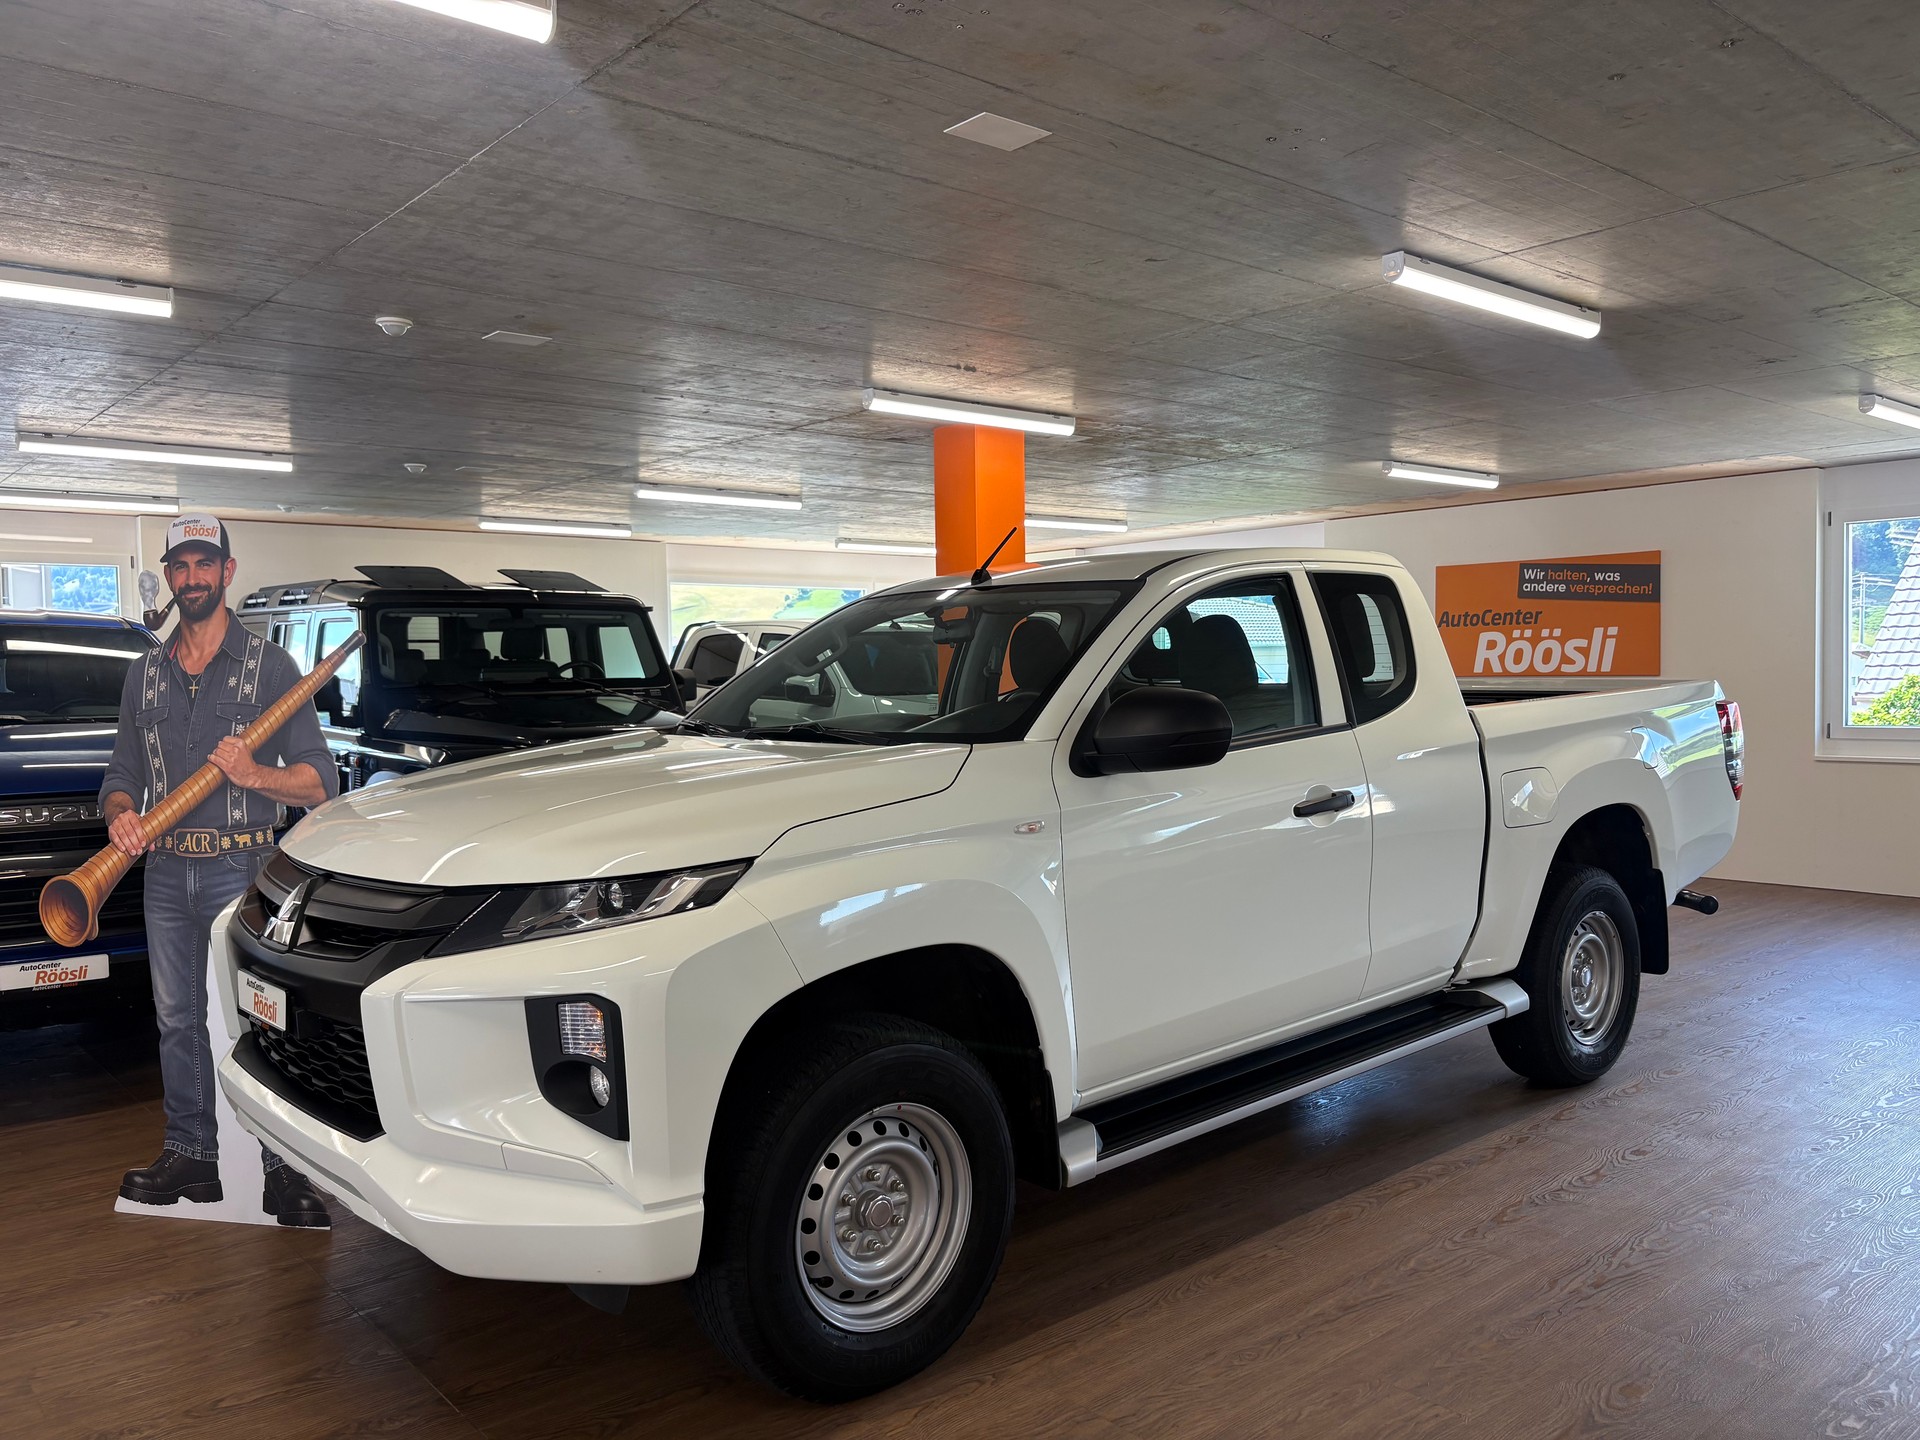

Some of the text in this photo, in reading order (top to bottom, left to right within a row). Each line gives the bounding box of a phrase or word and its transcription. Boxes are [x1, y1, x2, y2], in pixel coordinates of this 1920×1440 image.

[172, 519, 201, 528] AutoCenter
[183, 524, 219, 538] Röösli
[1523, 568, 1621, 582] Wir halten, was
[1522, 581, 1653, 596] andere versprechen!
[1437, 609, 1543, 628] AutoCenter
[1473, 626, 1619, 673] Röösli
[179, 833, 212, 853] ACR
[19, 962, 62, 972] AutoCenter
[34, 965, 89, 985] Röösli
[253, 992, 278, 1023] Röösli
